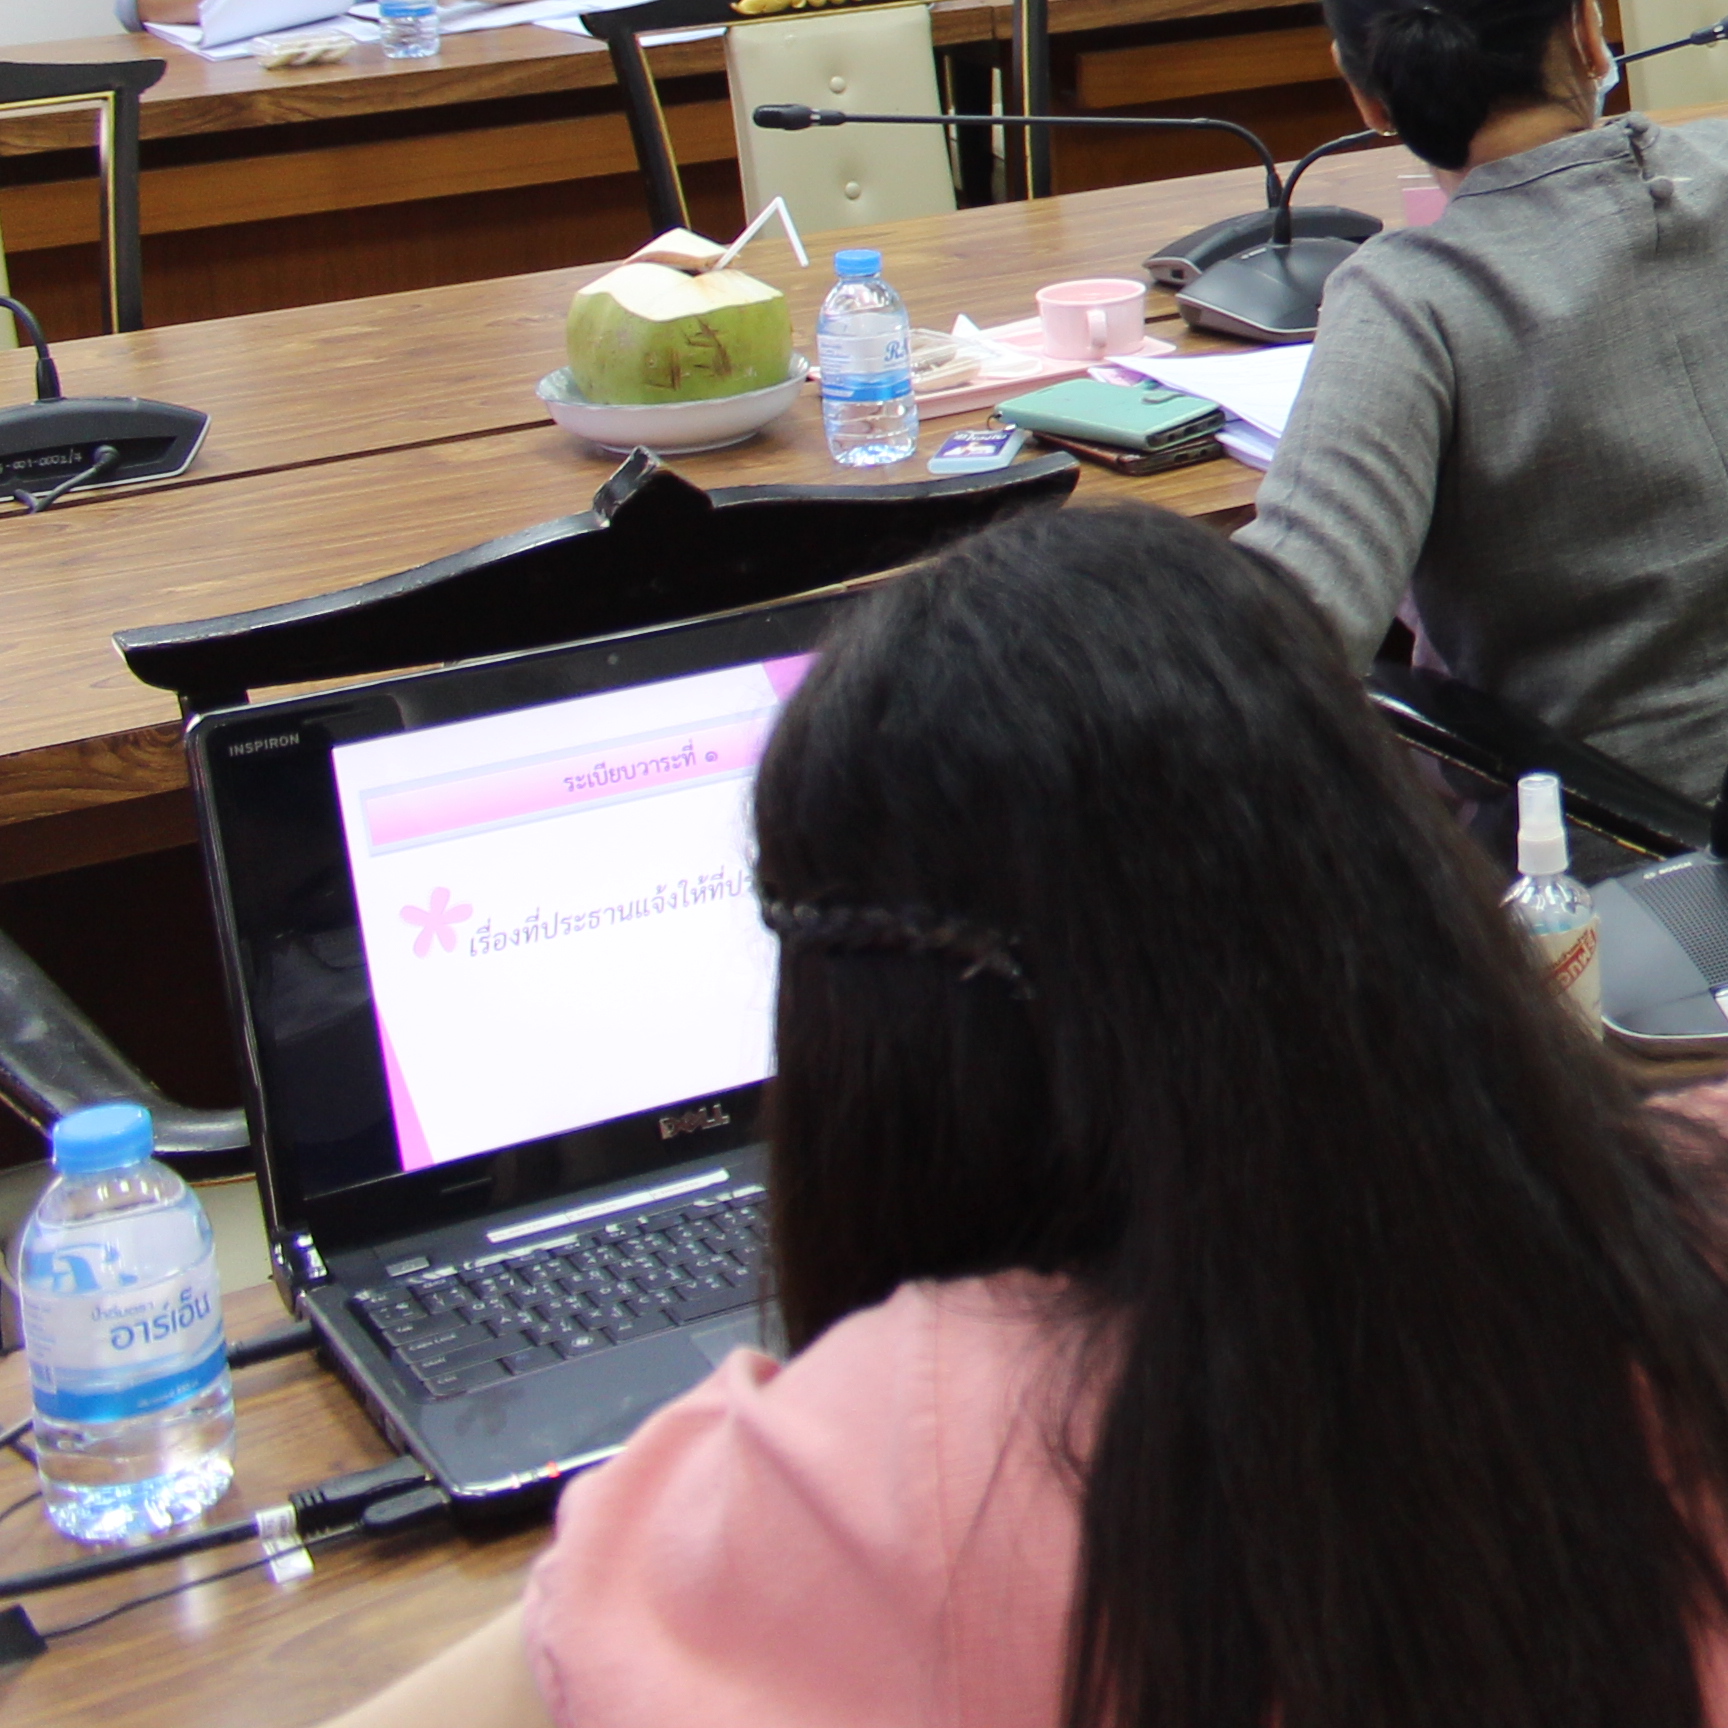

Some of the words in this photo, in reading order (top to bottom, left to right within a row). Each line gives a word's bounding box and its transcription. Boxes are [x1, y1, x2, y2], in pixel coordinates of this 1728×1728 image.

[229, 732, 300, 756] INSPIRON
[563, 739, 697, 792] ระเบียบวาระที่
[704, 749, 719, 763] ๑
[659, 1103, 730, 1140] DELL
[109, 1286, 212, 1350] อาร์เอ็น
